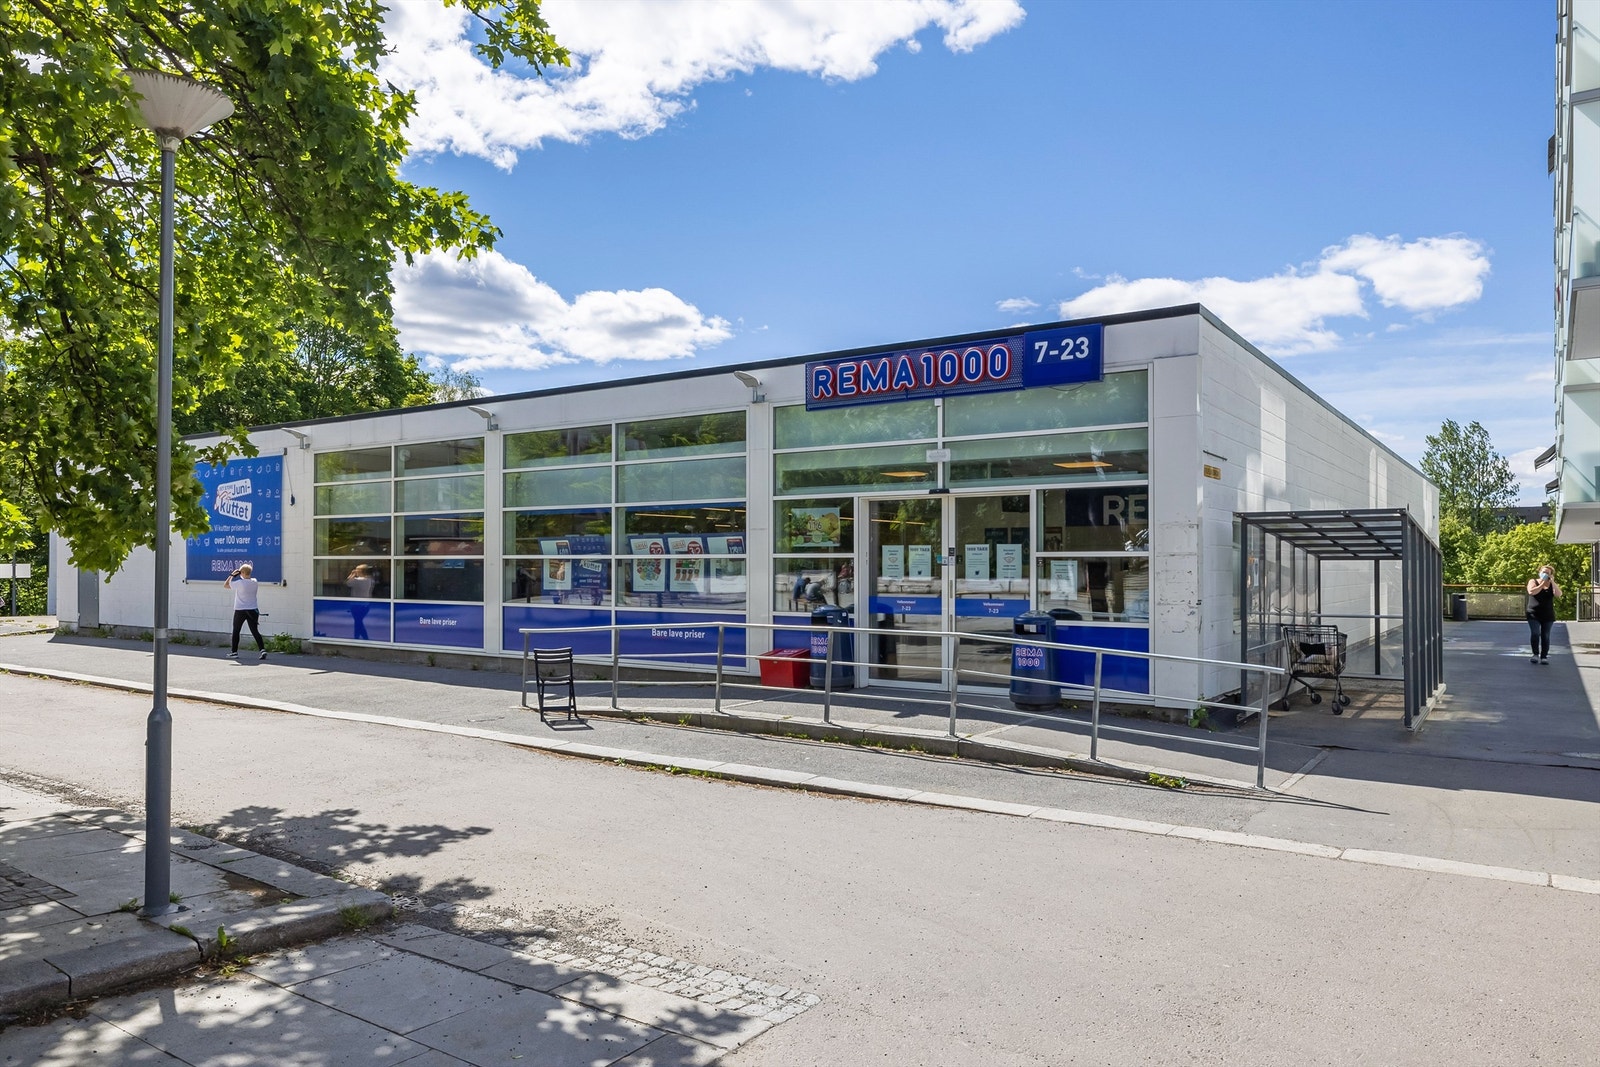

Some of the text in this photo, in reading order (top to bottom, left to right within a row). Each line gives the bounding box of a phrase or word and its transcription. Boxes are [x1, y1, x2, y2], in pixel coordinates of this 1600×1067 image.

[1033, 336, 1090, 363] 7-23
[811, 343, 1012, 400] REMA 1000
[232, 480, 251, 496] Juni-
[220, 498, 249, 520] kuttet
[231, 525, 244, 533] prisen
[214, 535, 251, 545] over 100 varer
[211, 560, 234, 572] REMA
[419, 617, 457, 627] Bare lave priser
[651, 628, 705, 639] Bare lave priser
[1015, 647, 1043, 657] REMA
[1017, 657, 1040, 667] 1000
